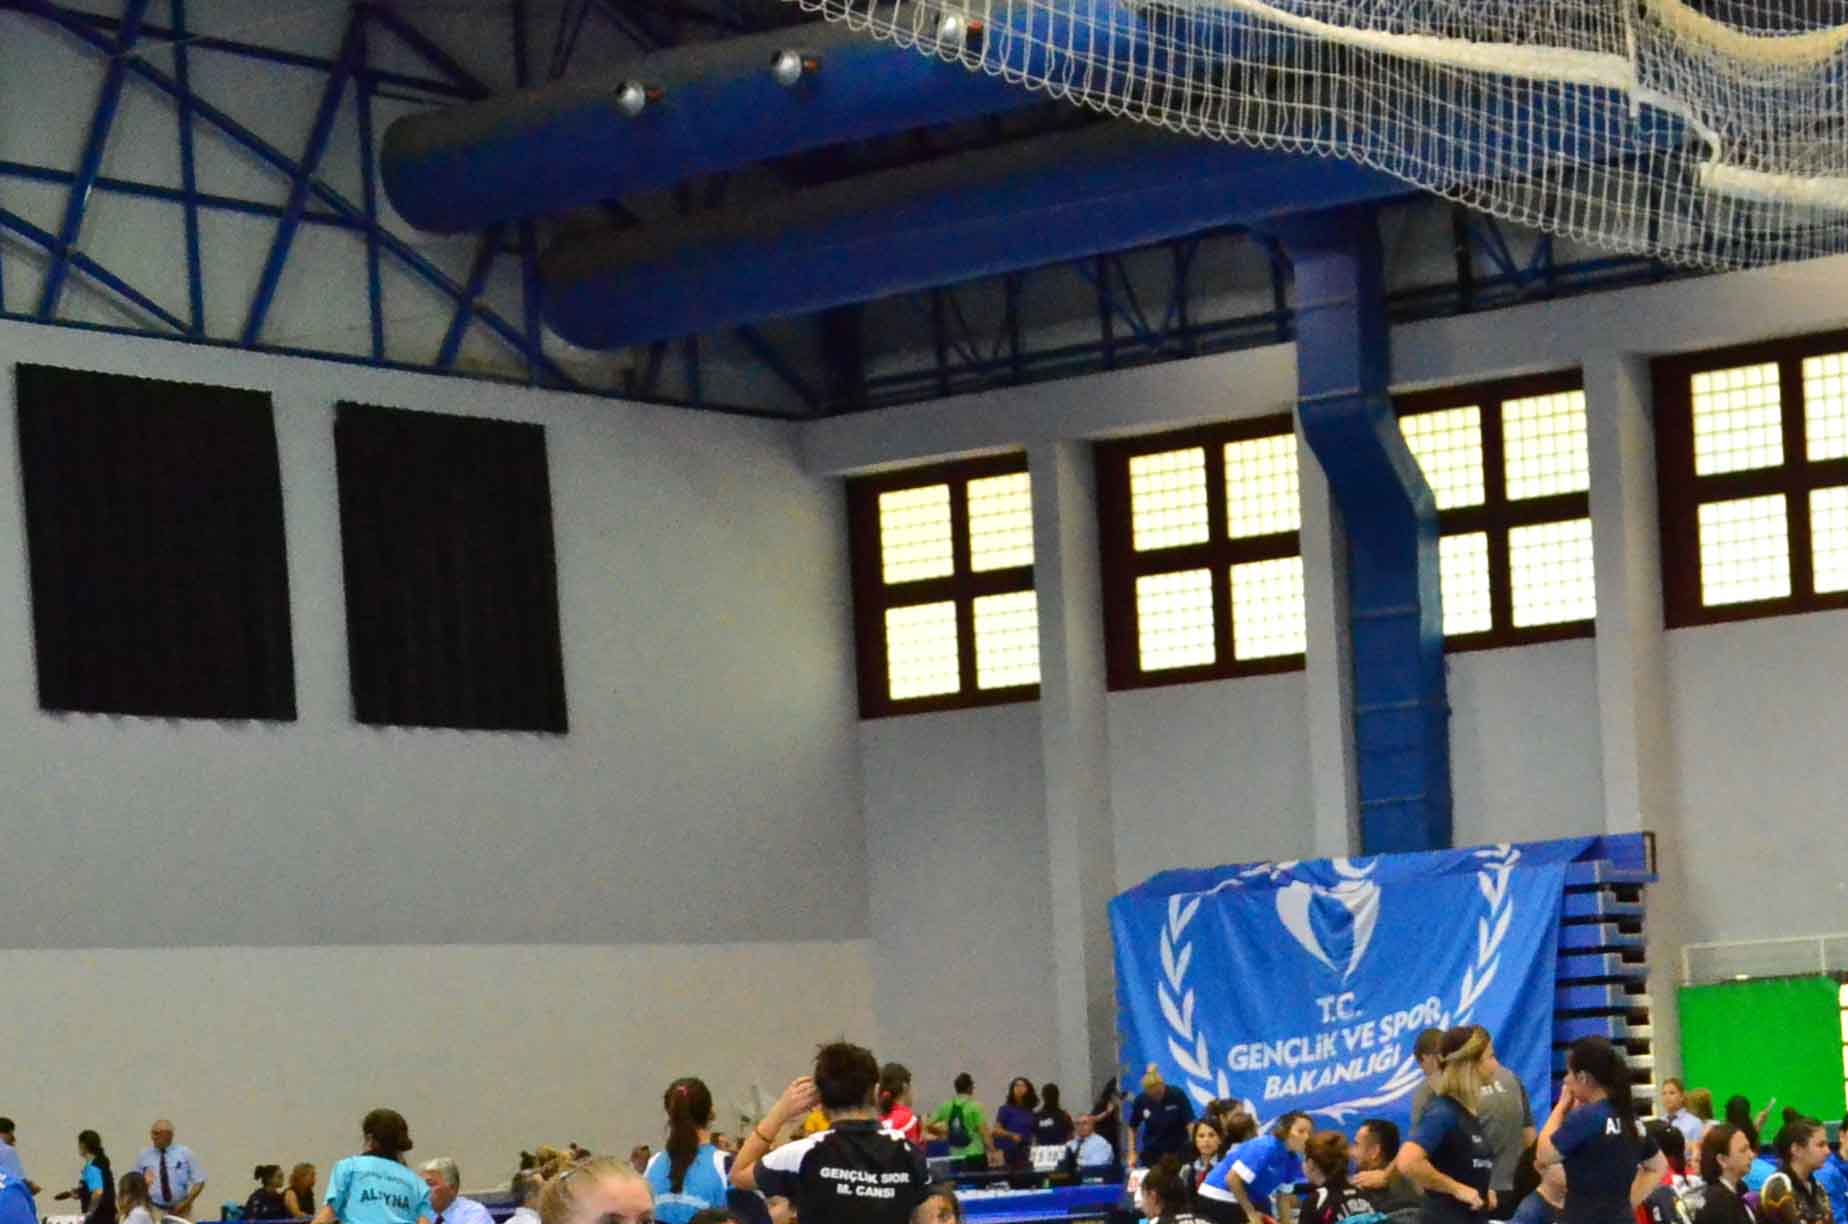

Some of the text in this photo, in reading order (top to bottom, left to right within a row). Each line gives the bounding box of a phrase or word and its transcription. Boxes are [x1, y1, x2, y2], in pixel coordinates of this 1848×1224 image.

[1316, 991, 1363, 1024] T.C.
[1228, 995, 1442, 1072] GENÇLİK VE SPOR
[1264, 1044, 1401, 1100] BAKANLIĞI
[820, 1167, 878, 1184] GENÇLİK
